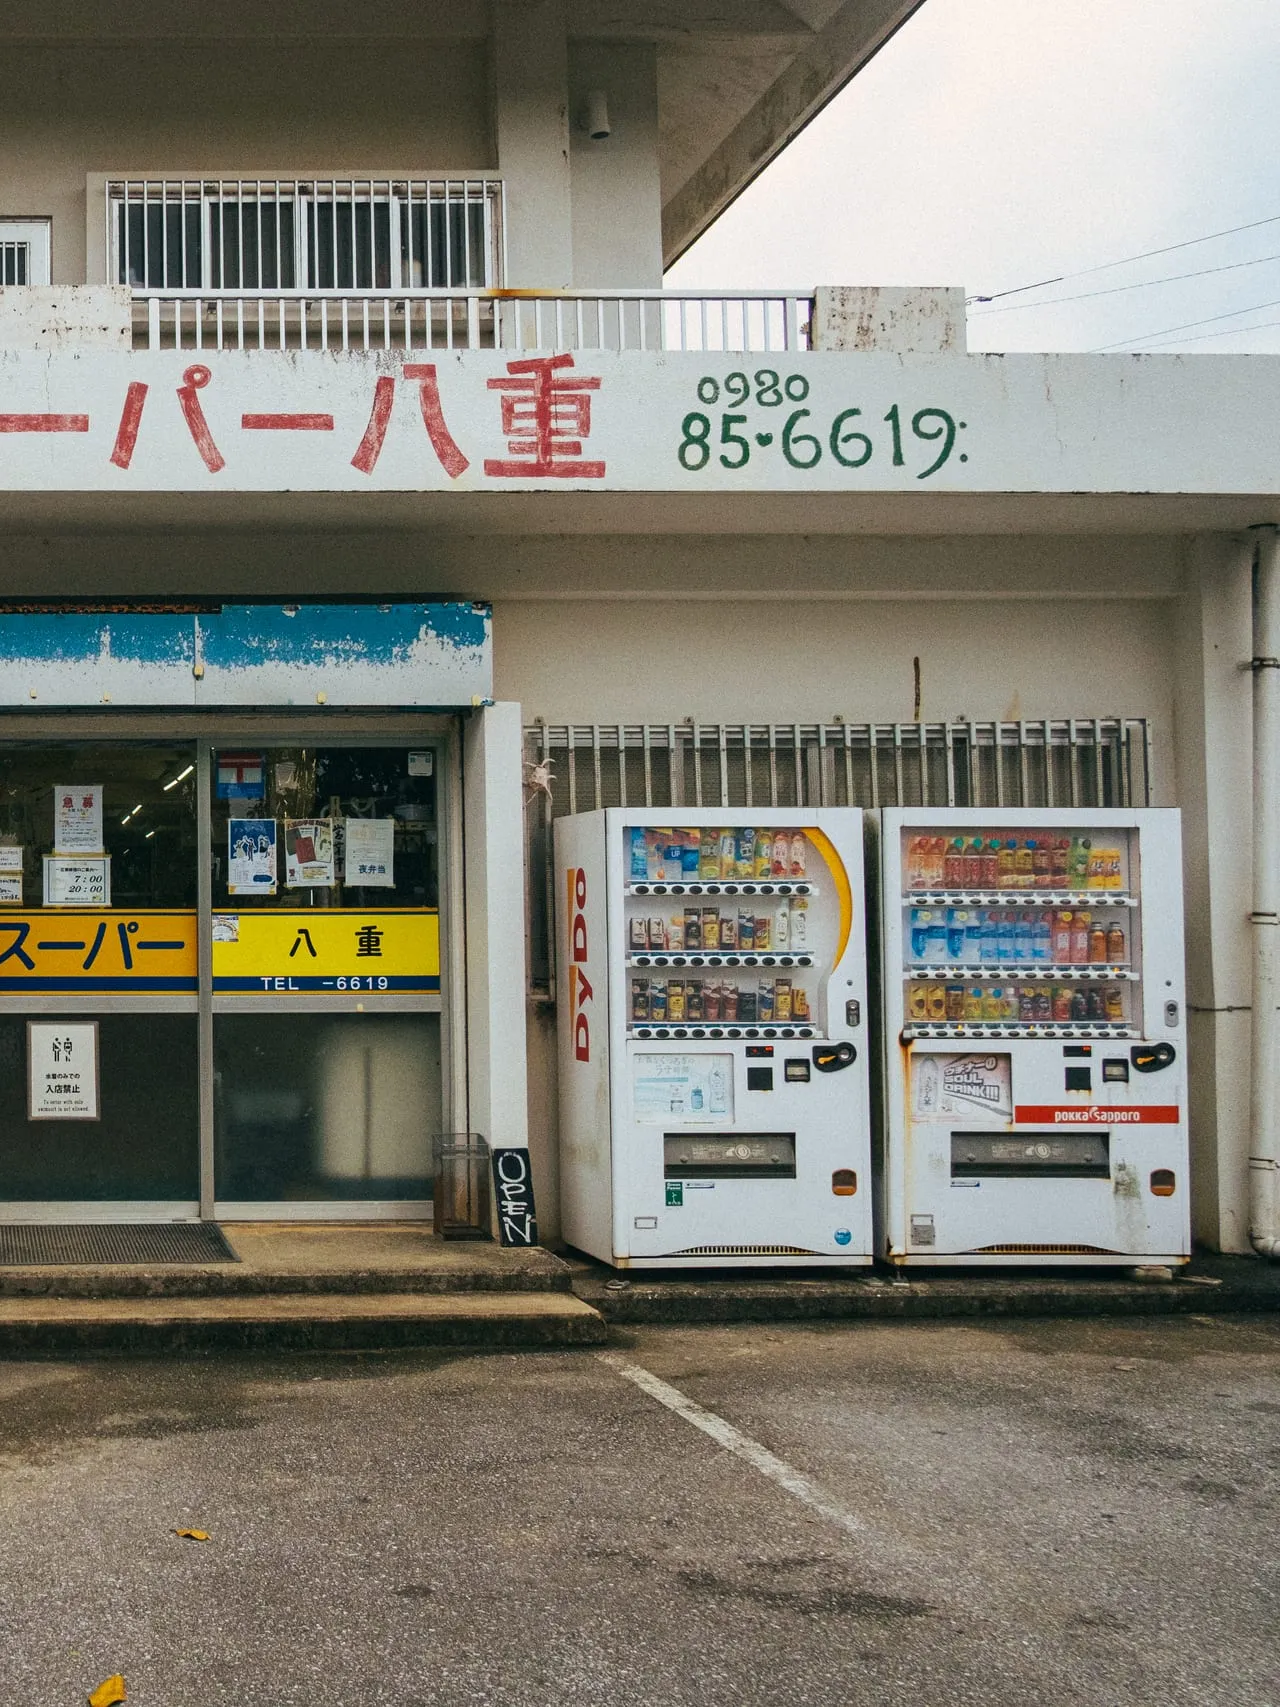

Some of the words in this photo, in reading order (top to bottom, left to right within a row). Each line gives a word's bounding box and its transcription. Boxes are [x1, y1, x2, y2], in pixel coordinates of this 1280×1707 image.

[697, 369, 810, 409] 0980
[260, 976, 299, 991] TEL
[944, 1073, 984, 1084] SOUL
[498, 1151, 532, 1243] OPEN
